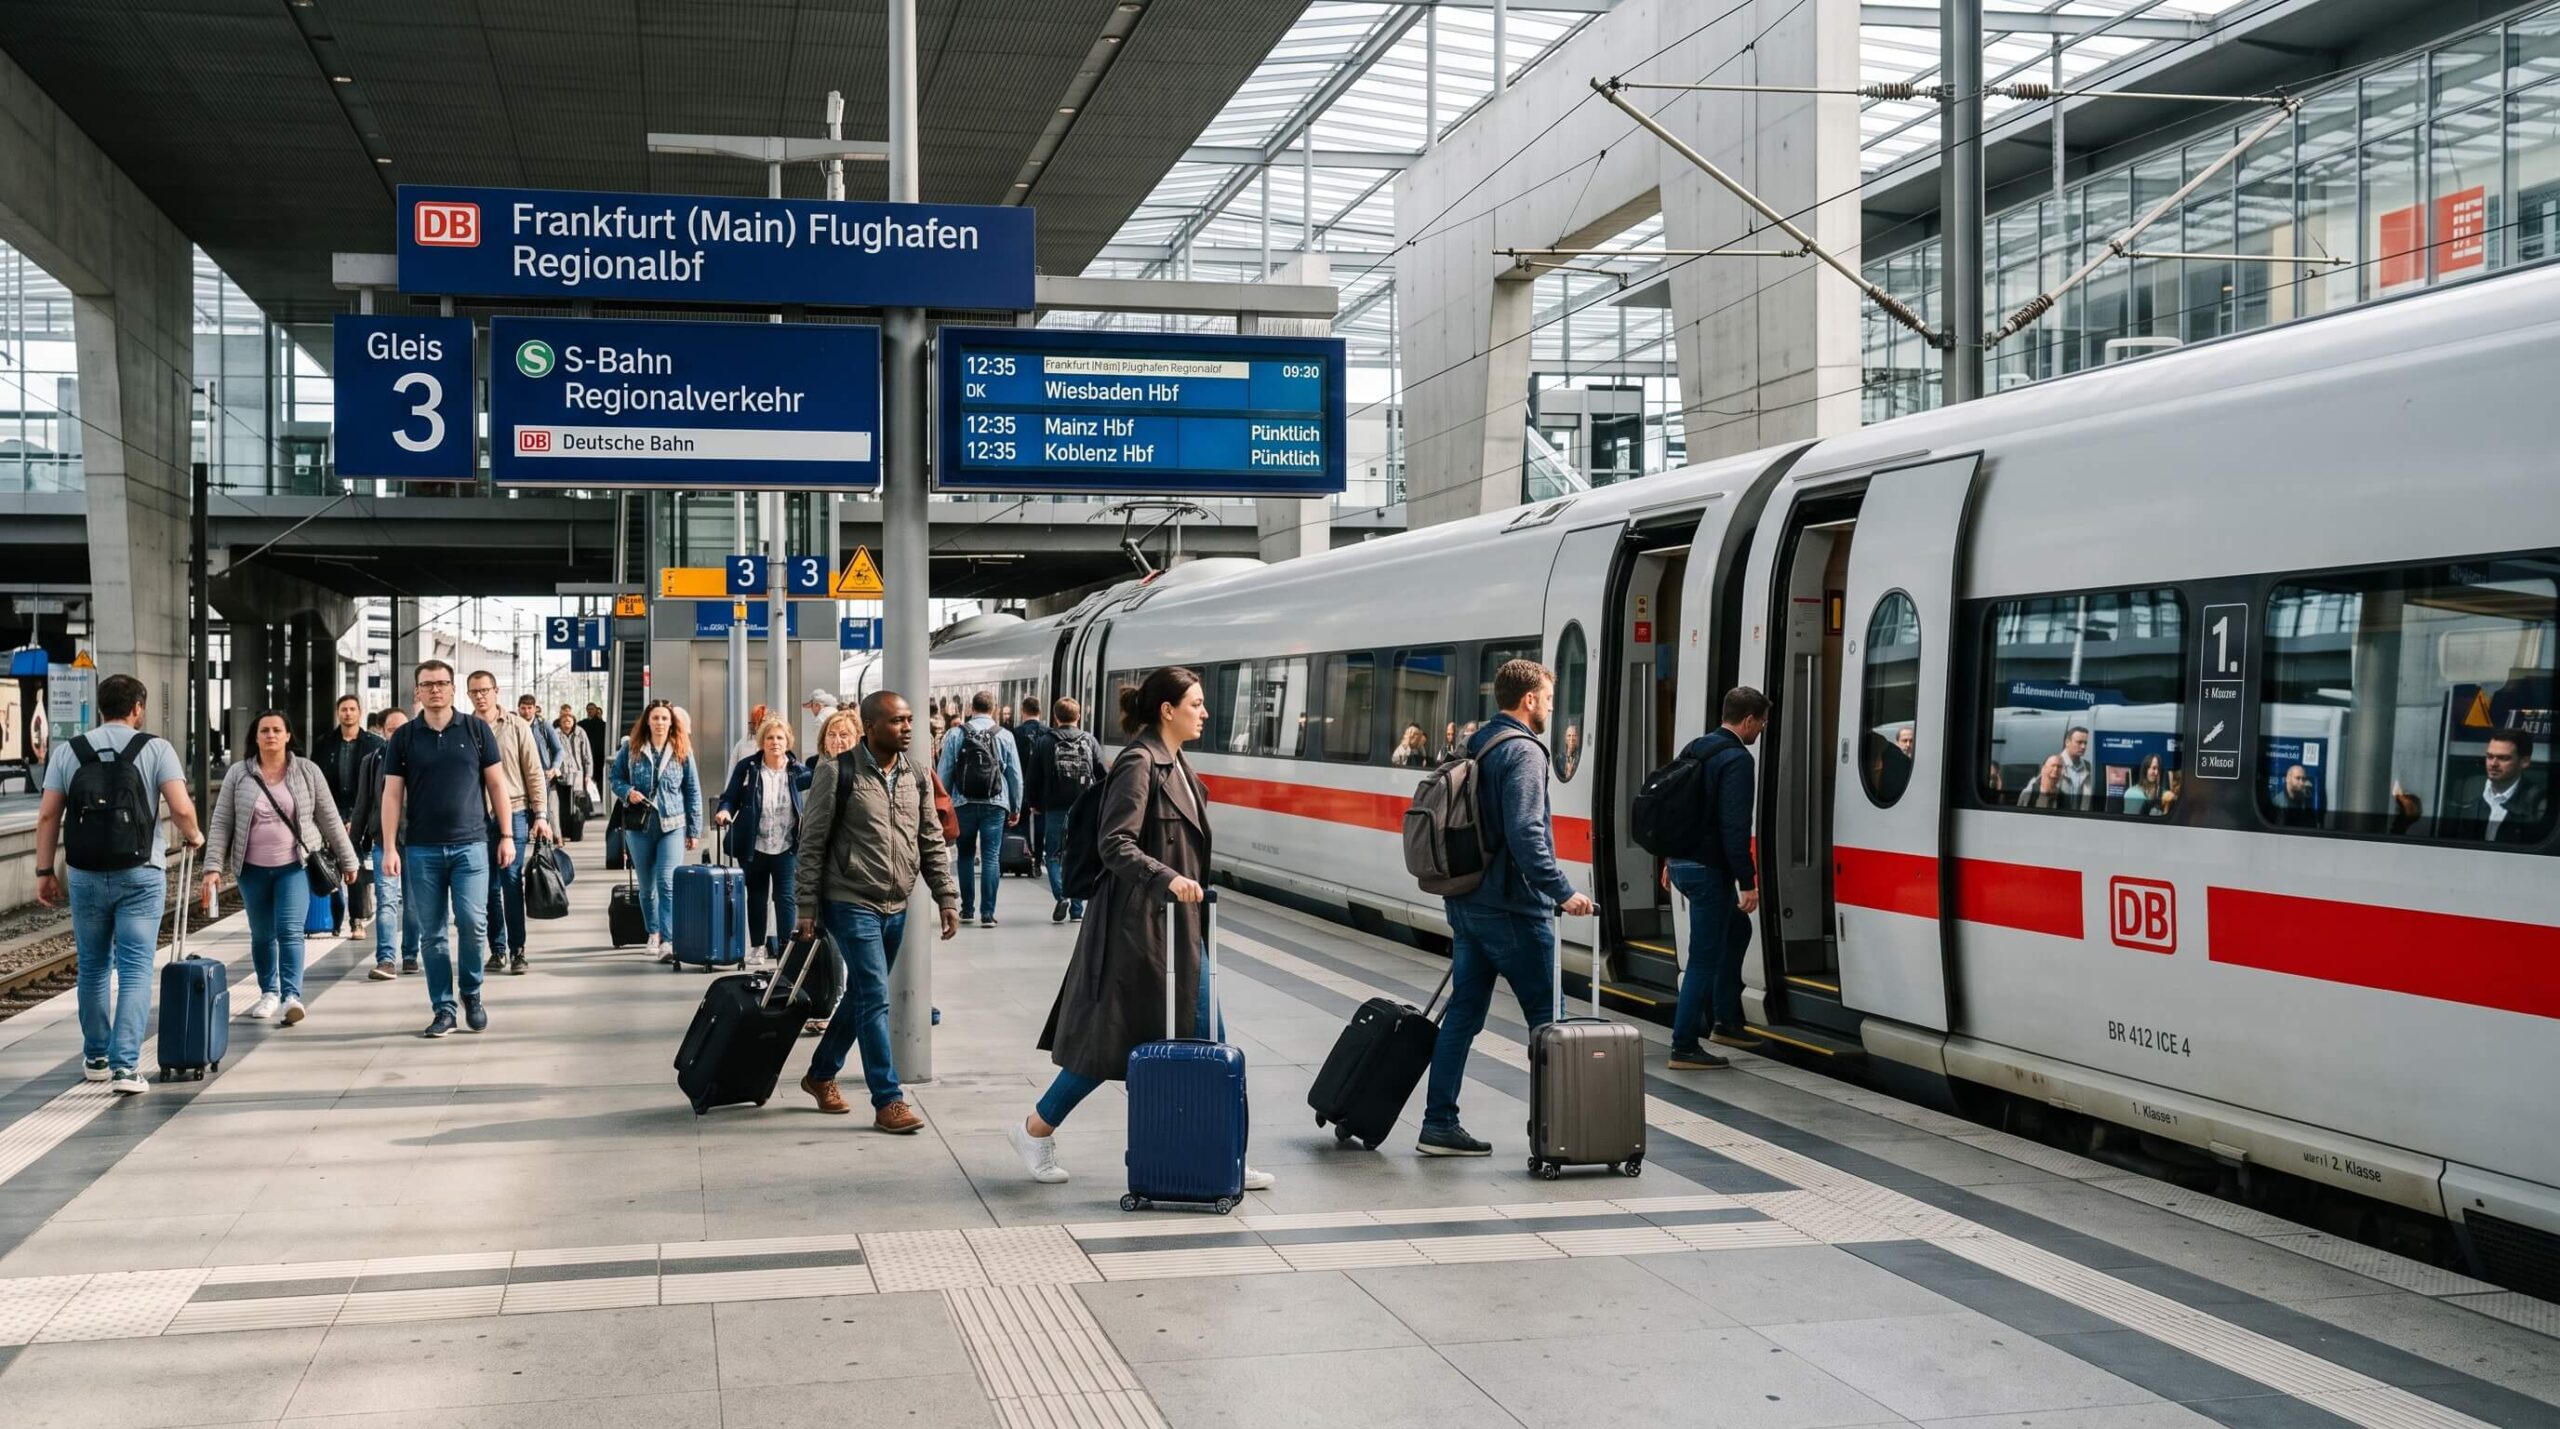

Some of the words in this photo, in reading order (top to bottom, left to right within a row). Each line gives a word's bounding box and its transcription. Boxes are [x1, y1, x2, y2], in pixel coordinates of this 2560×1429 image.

[424, 209, 472, 239] DB
[513, 203, 677, 240] Frankfurt
[688, 206, 797, 248] (Main)
[809, 213, 979, 254] Flughafen
[513, 245, 705, 286] Regionalbf
[367, 331, 443, 361] Gleis
[523, 344, 548, 374] S
[564, 346, 673, 375] S-Bahn
[967, 356, 1016, 376] 12:35
[1045, 359, 1090, 371] Frankfurt
[1282, 365, 1320, 379] 09:30
[565, 382, 805, 416] Regionalverkehr
[1045, 380, 1143, 401] Wiesbaden
[1148, 383, 1180, 402] Hbf
[391, 372, 446, 452] 3
[967, 415, 1017, 435] 12:35
[1045, 417, 1098, 437] Mainz
[1103, 418, 1135, 437] Hbf
[1251, 425, 1320, 442] Pünktlich
[523, 433, 547, 449] DB
[563, 434, 645, 451] Deutsche
[651, 435, 695, 452] Bahn
[967, 440, 1017, 461] 12:35
[1045, 442, 1117, 463] Koblenz
[1122, 444, 1155, 463] Hbf
[1251, 449, 1320, 467] Pünktlich
[737, 558, 755, 587] 3
[801, 558, 819, 587] 3
[552, 618, 570, 643] 3
[2212, 616, 2238, 673] 1.
[2118, 887, 2169, 941] DB
[2108, 1020, 2127, 1043] BR
[2129, 1025, 2153, 1049] 412
[2156, 1030, 2179, 1055] ICE
[2181, 1036, 2192, 1058] 4
[2142, 1104, 2172, 1124] Klasse
[2345, 1159, 2382, 1183] Klasse
